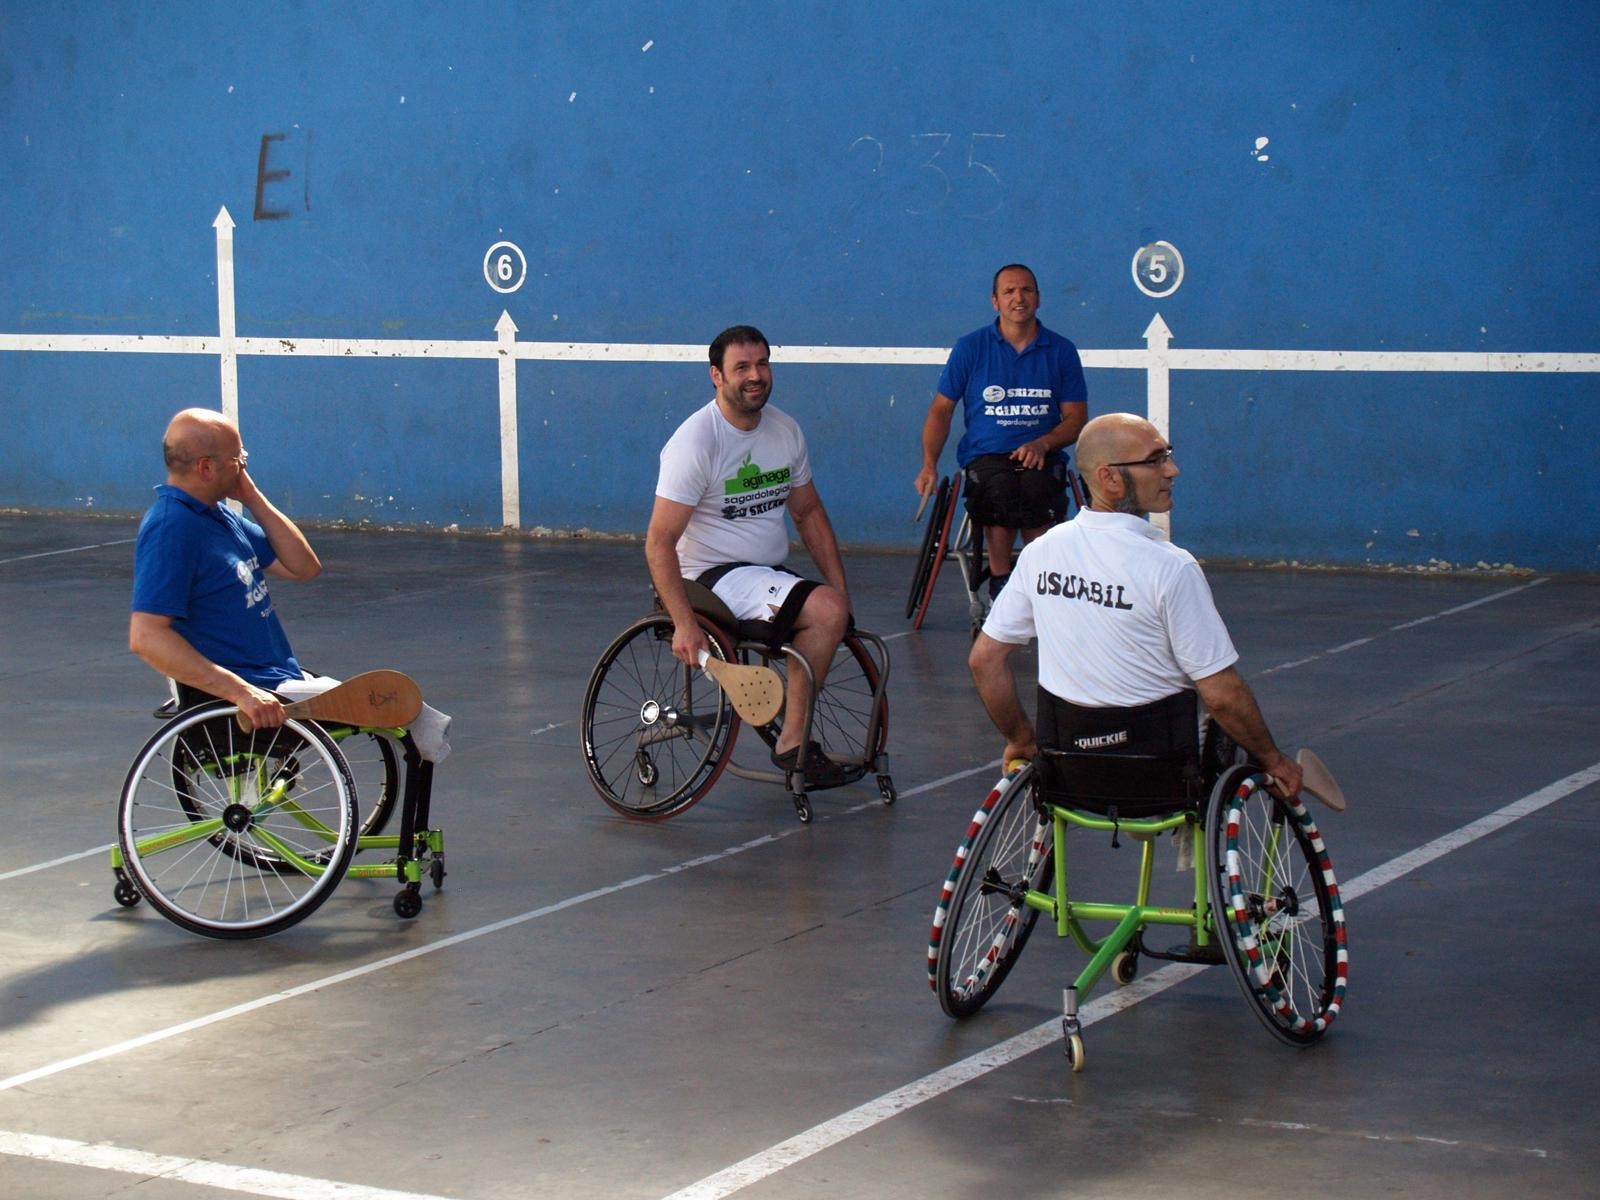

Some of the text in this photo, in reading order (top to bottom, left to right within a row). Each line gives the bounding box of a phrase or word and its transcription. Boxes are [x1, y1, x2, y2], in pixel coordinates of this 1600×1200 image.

[498, 254, 513, 281] 6
[1149, 254, 1168, 284] 5
[742, 468, 791, 490] aginaga
[1078, 730, 1128, 749] QUICKIE
